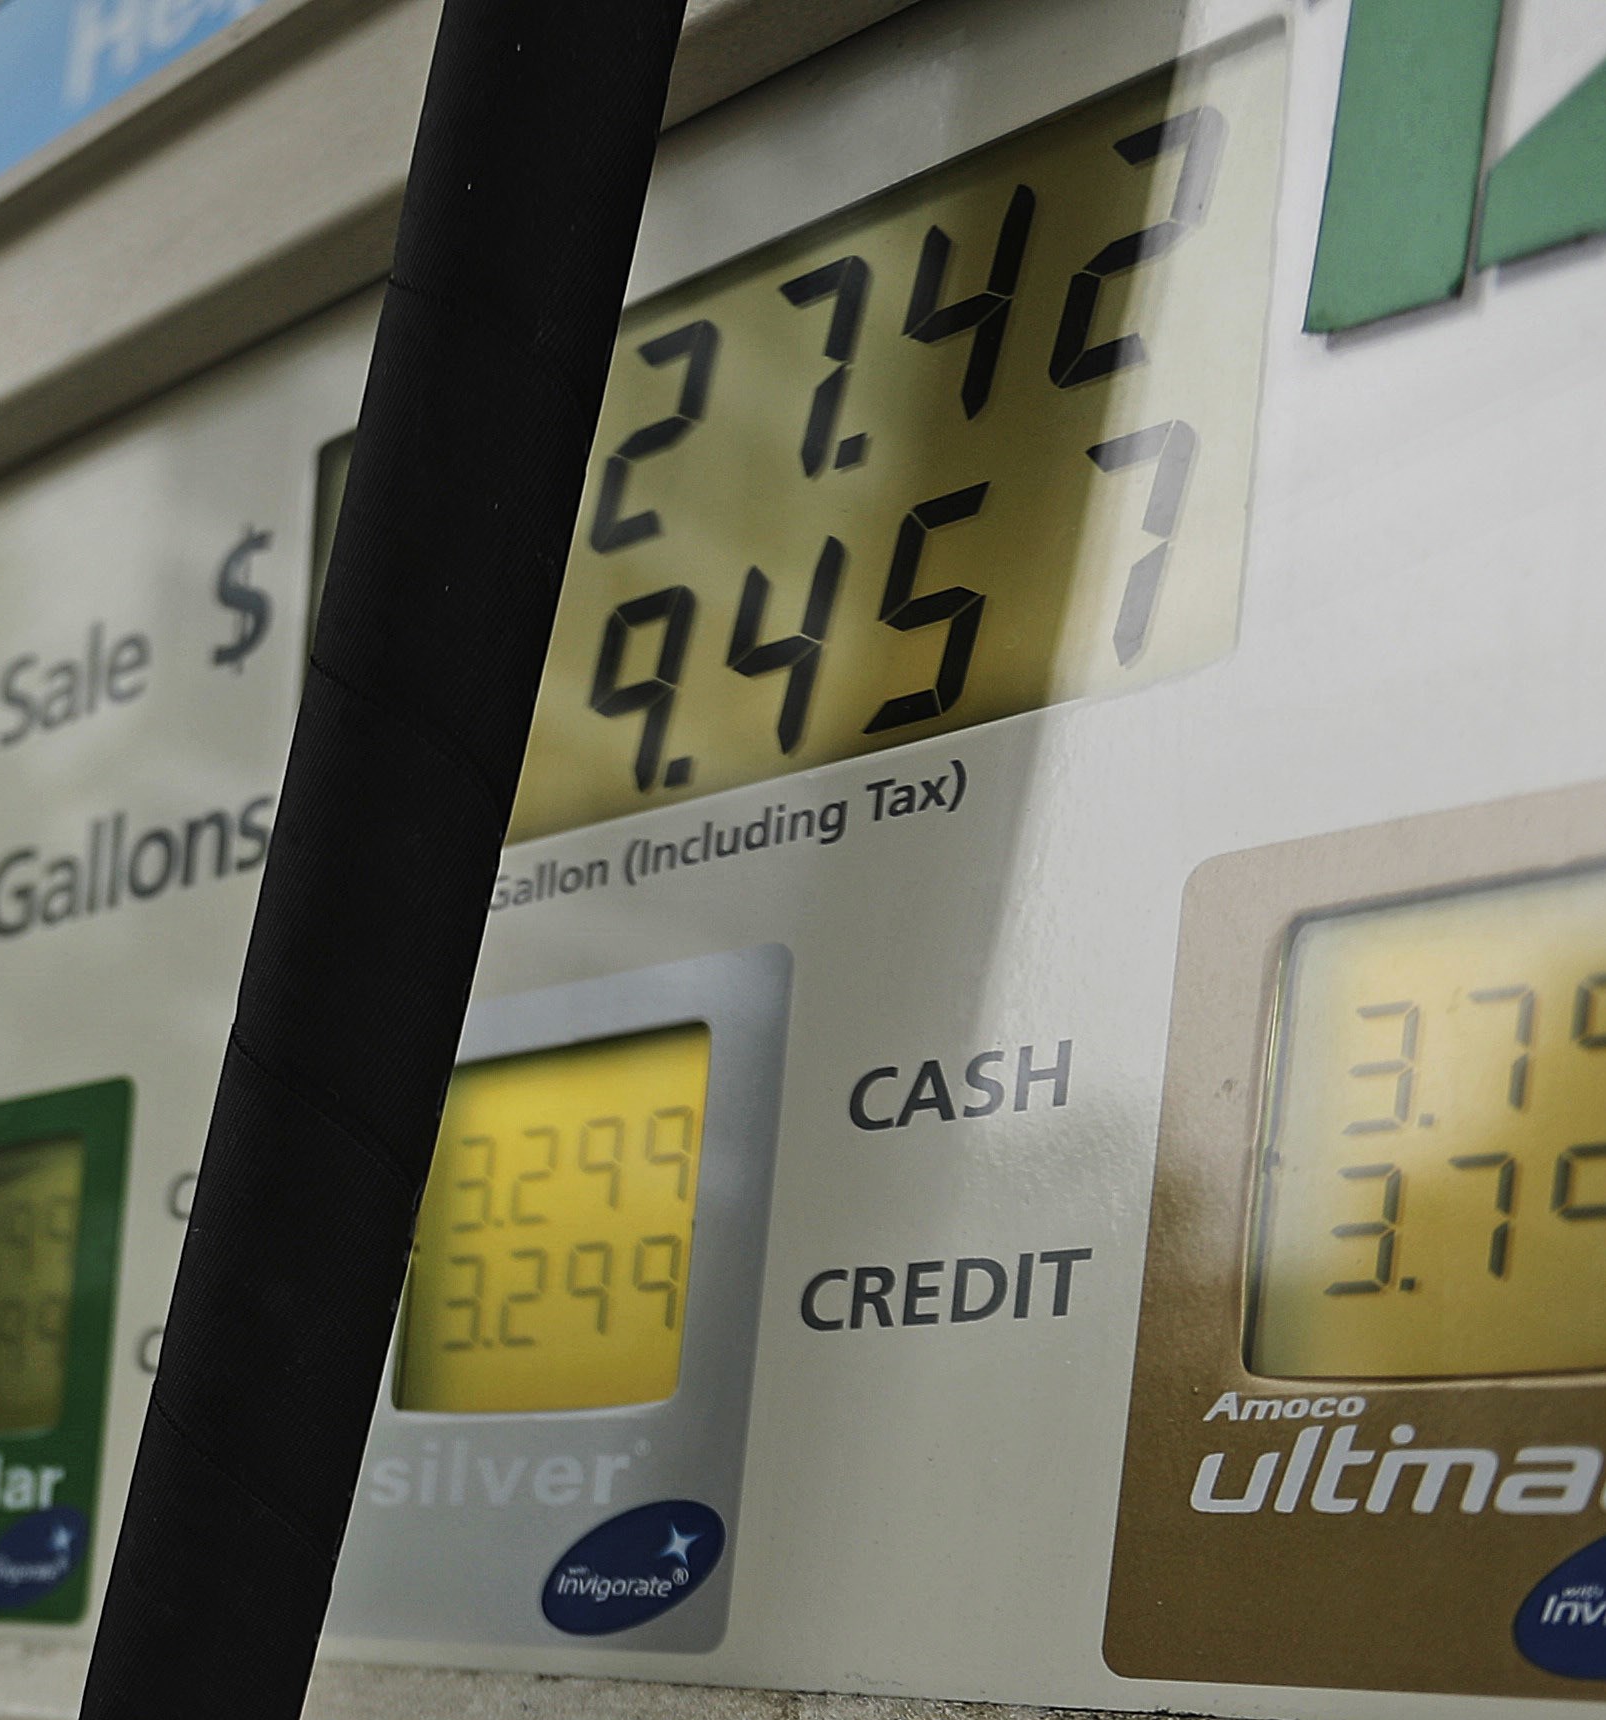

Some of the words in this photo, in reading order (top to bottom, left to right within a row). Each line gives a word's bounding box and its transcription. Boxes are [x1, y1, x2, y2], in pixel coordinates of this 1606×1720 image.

[589, 105, 1229, 554] 27.42
[208, 519, 274, 676] $
[589, 418, 1200, 791] 9.457
[623, 796, 848, 887] (Including
[866, 759, 969, 823] Tax)
[849, 1040, 1073, 1132] CASH
[451, 1105, 694, 1233] 3.299
[442, 1235, 683, 1352] 3.299
[800, 1247, 1093, 1332] CREDIT
[1202, 1391, 1367, 1422] Amoco
[1190, 1422, 1606, 1515] ultima
[1540, 1594, 1606, 1626] Inv
